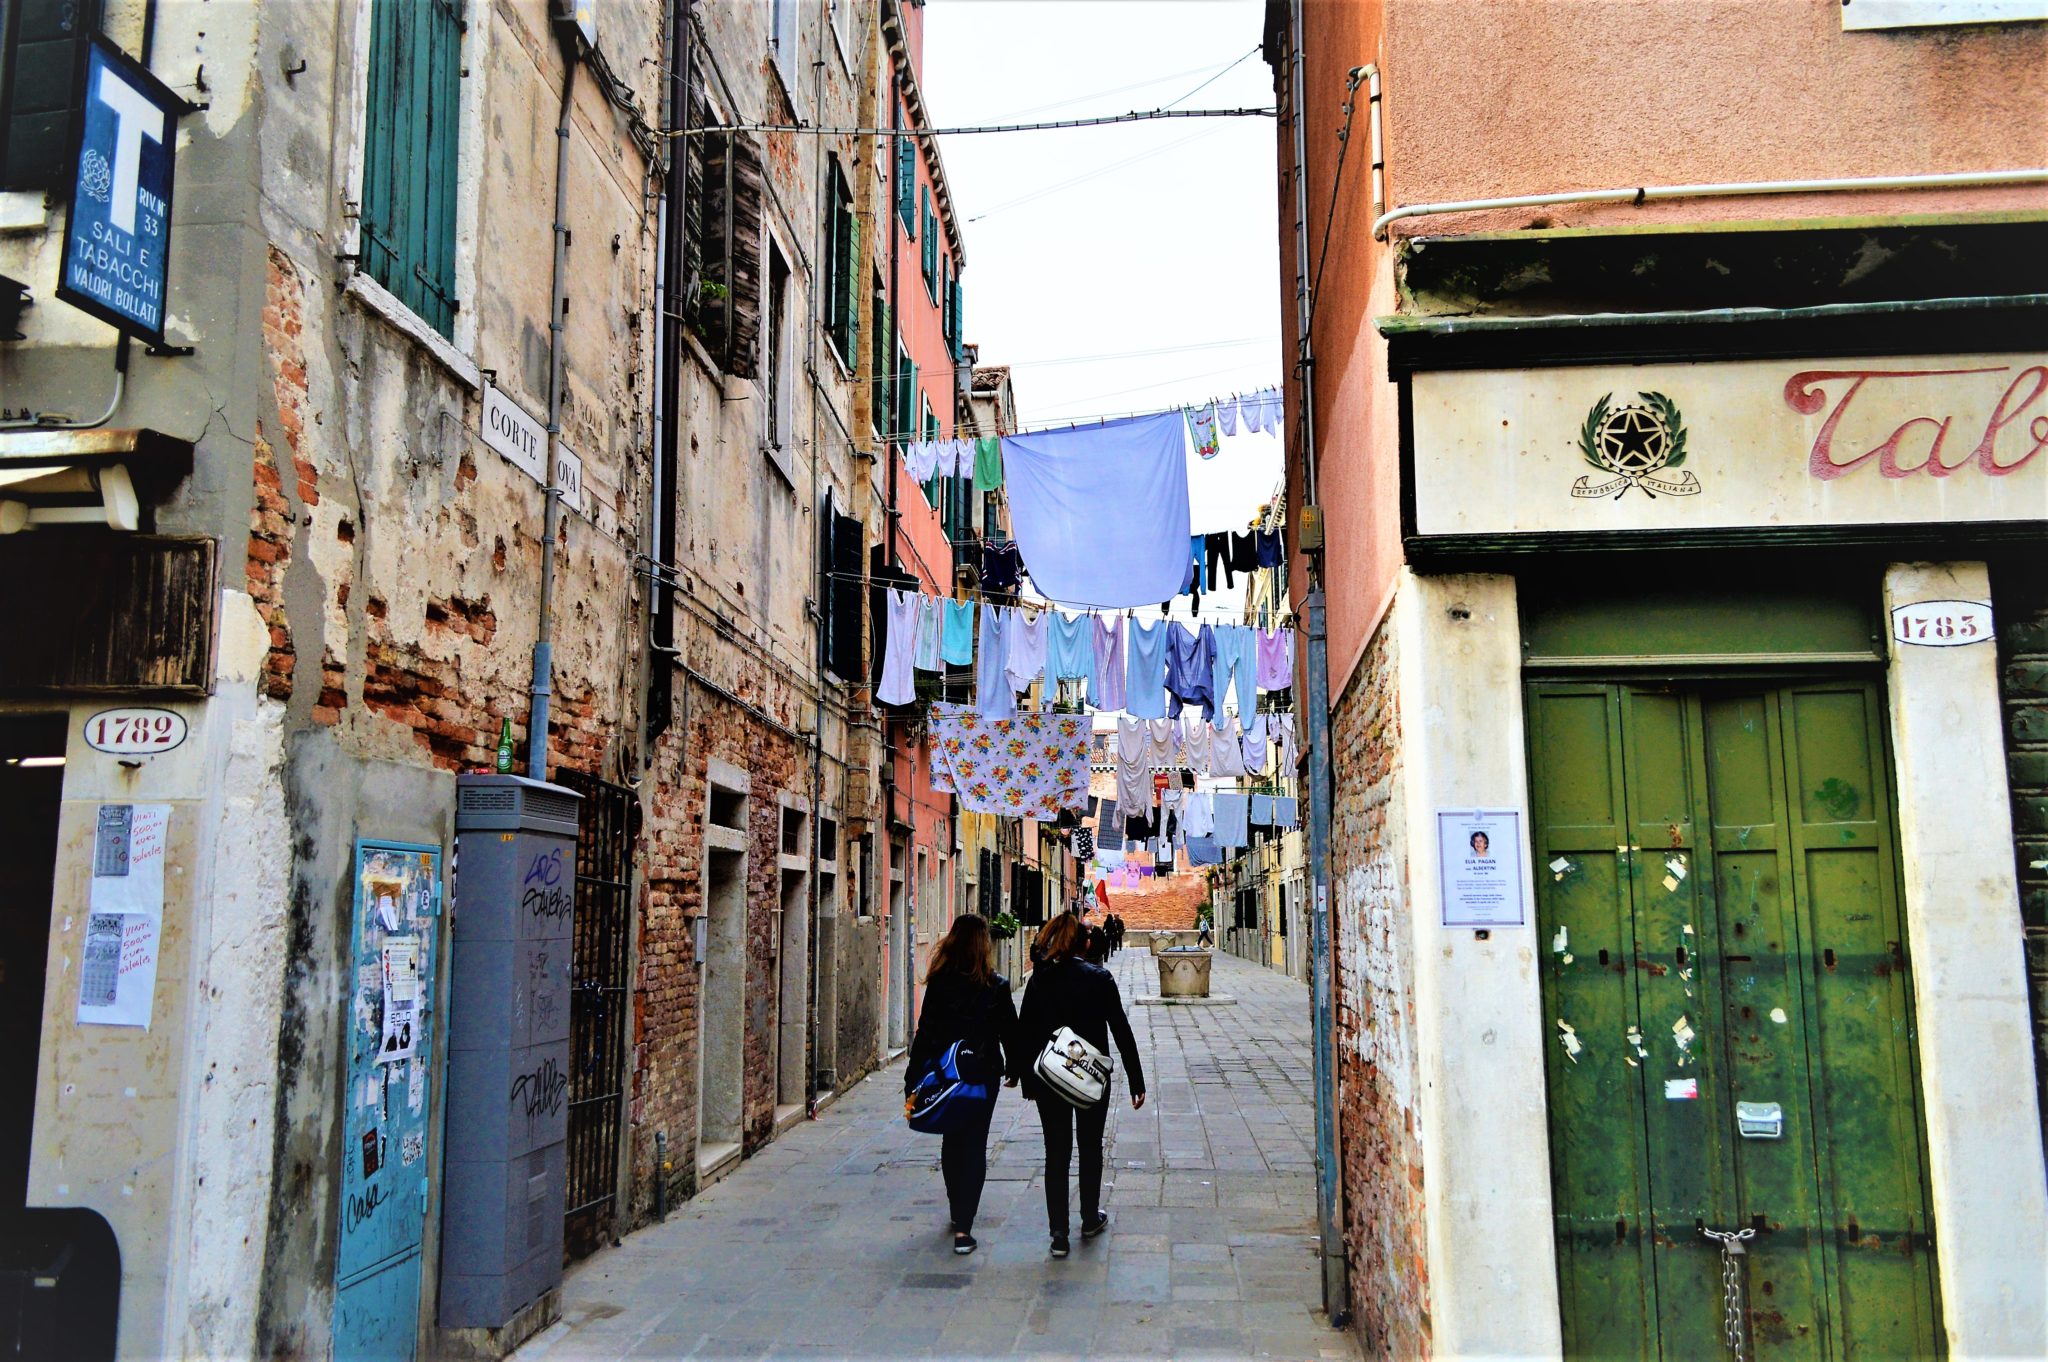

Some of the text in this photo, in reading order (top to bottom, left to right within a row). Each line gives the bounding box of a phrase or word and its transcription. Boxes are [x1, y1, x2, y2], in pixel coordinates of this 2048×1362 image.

[99, 65, 165, 236] T
[92, 221, 150, 268] SALI E
[144, 214, 159, 237] 33
[77, 236, 159, 300] TABACCHI
[74, 264, 157, 325] VALORI BOLLATI
[490, 405, 537, 461] CORTE
[557, 459, 577, 494] OVA
[1576, 478, 1694, 496] REPUBBLICA ITALIANA
[1902, 615, 1978, 639] 1783
[96, 715, 173, 745] 1782
